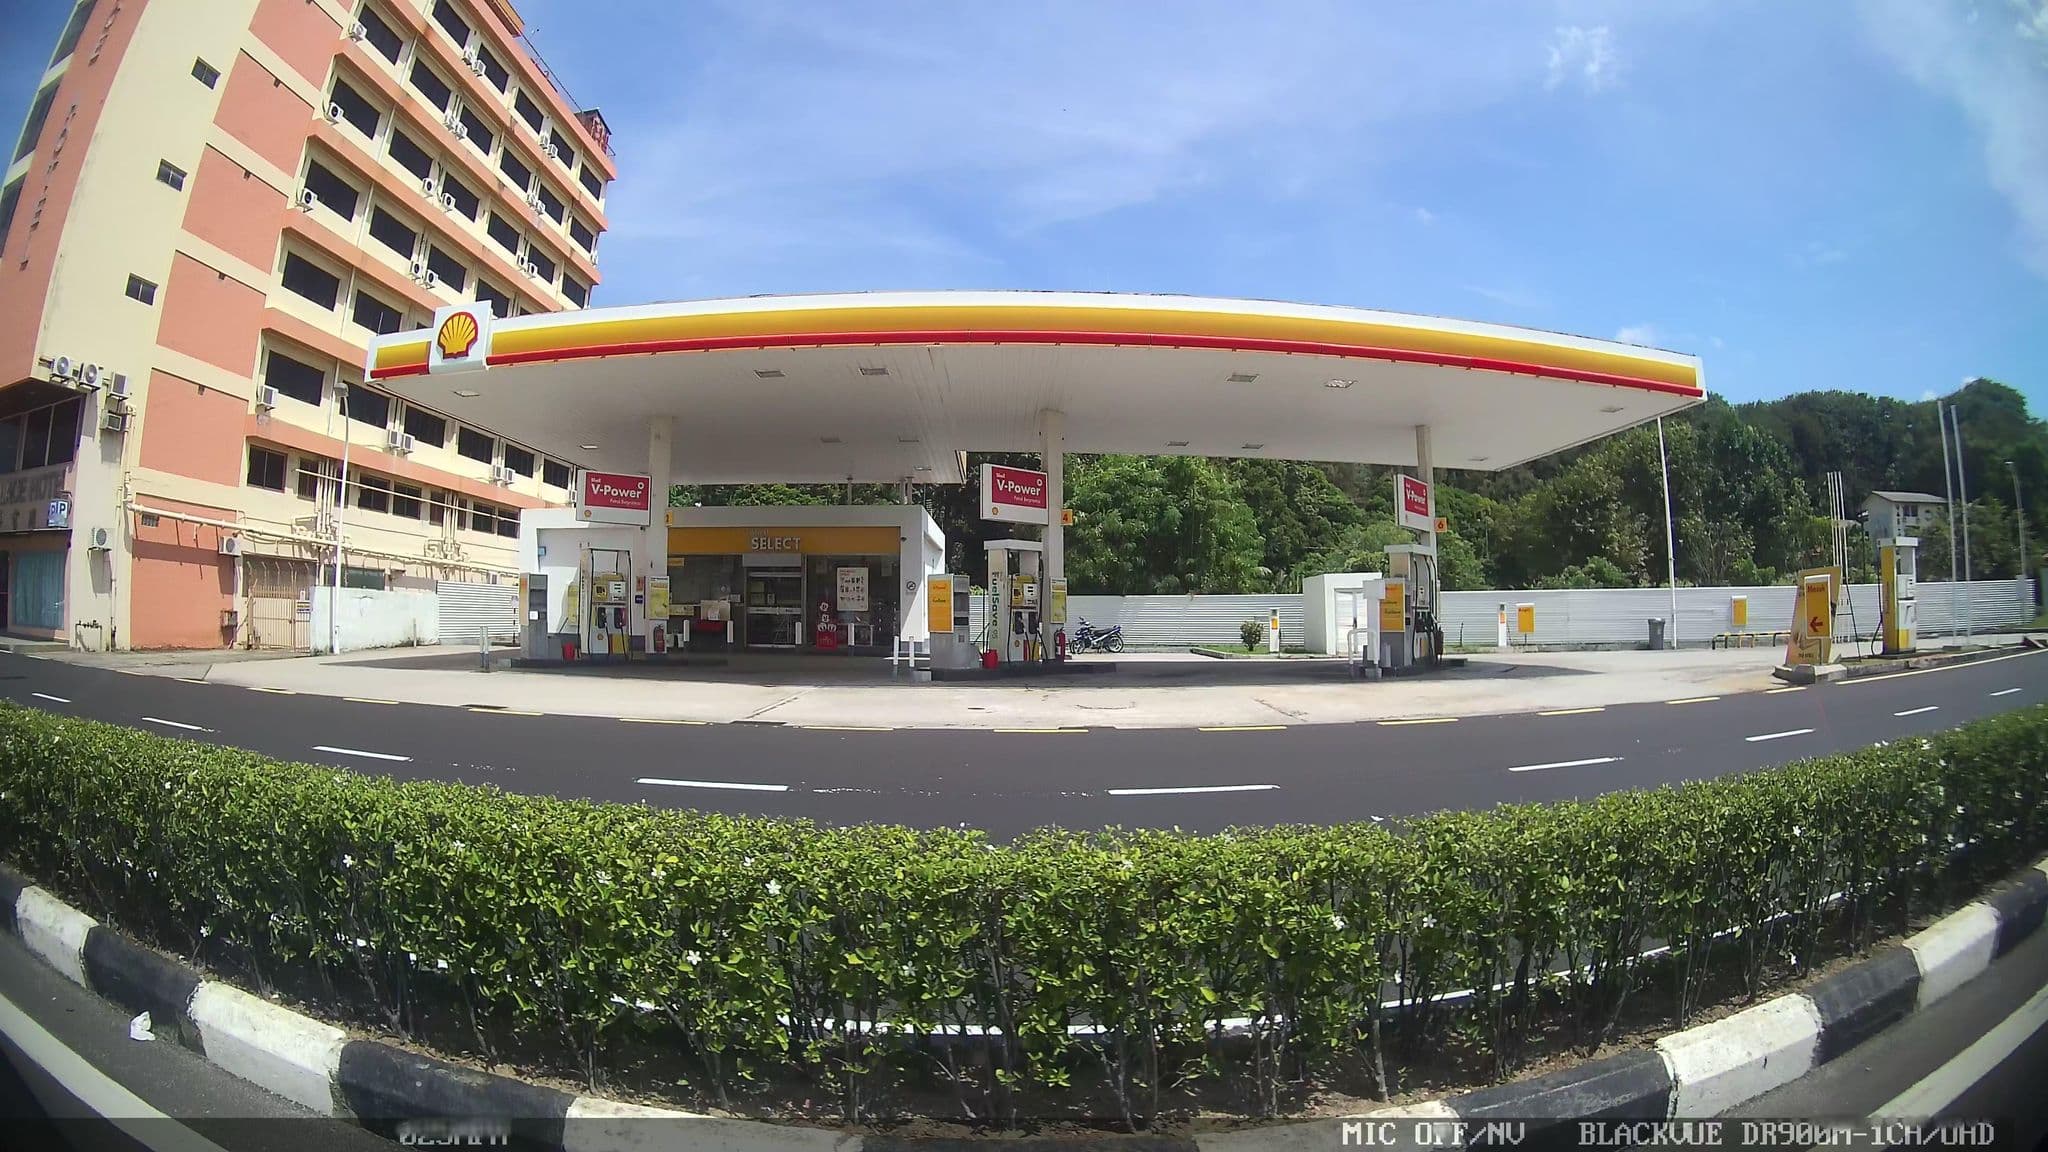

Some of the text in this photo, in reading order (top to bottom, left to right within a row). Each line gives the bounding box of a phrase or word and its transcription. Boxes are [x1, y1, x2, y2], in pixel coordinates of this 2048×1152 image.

[591, 483, 642, 499] V-Power
[996, 479, 1041, 496] V-Power
[1062, 513, 1069, 522] 4
[751, 537, 801, 550] SELECT
